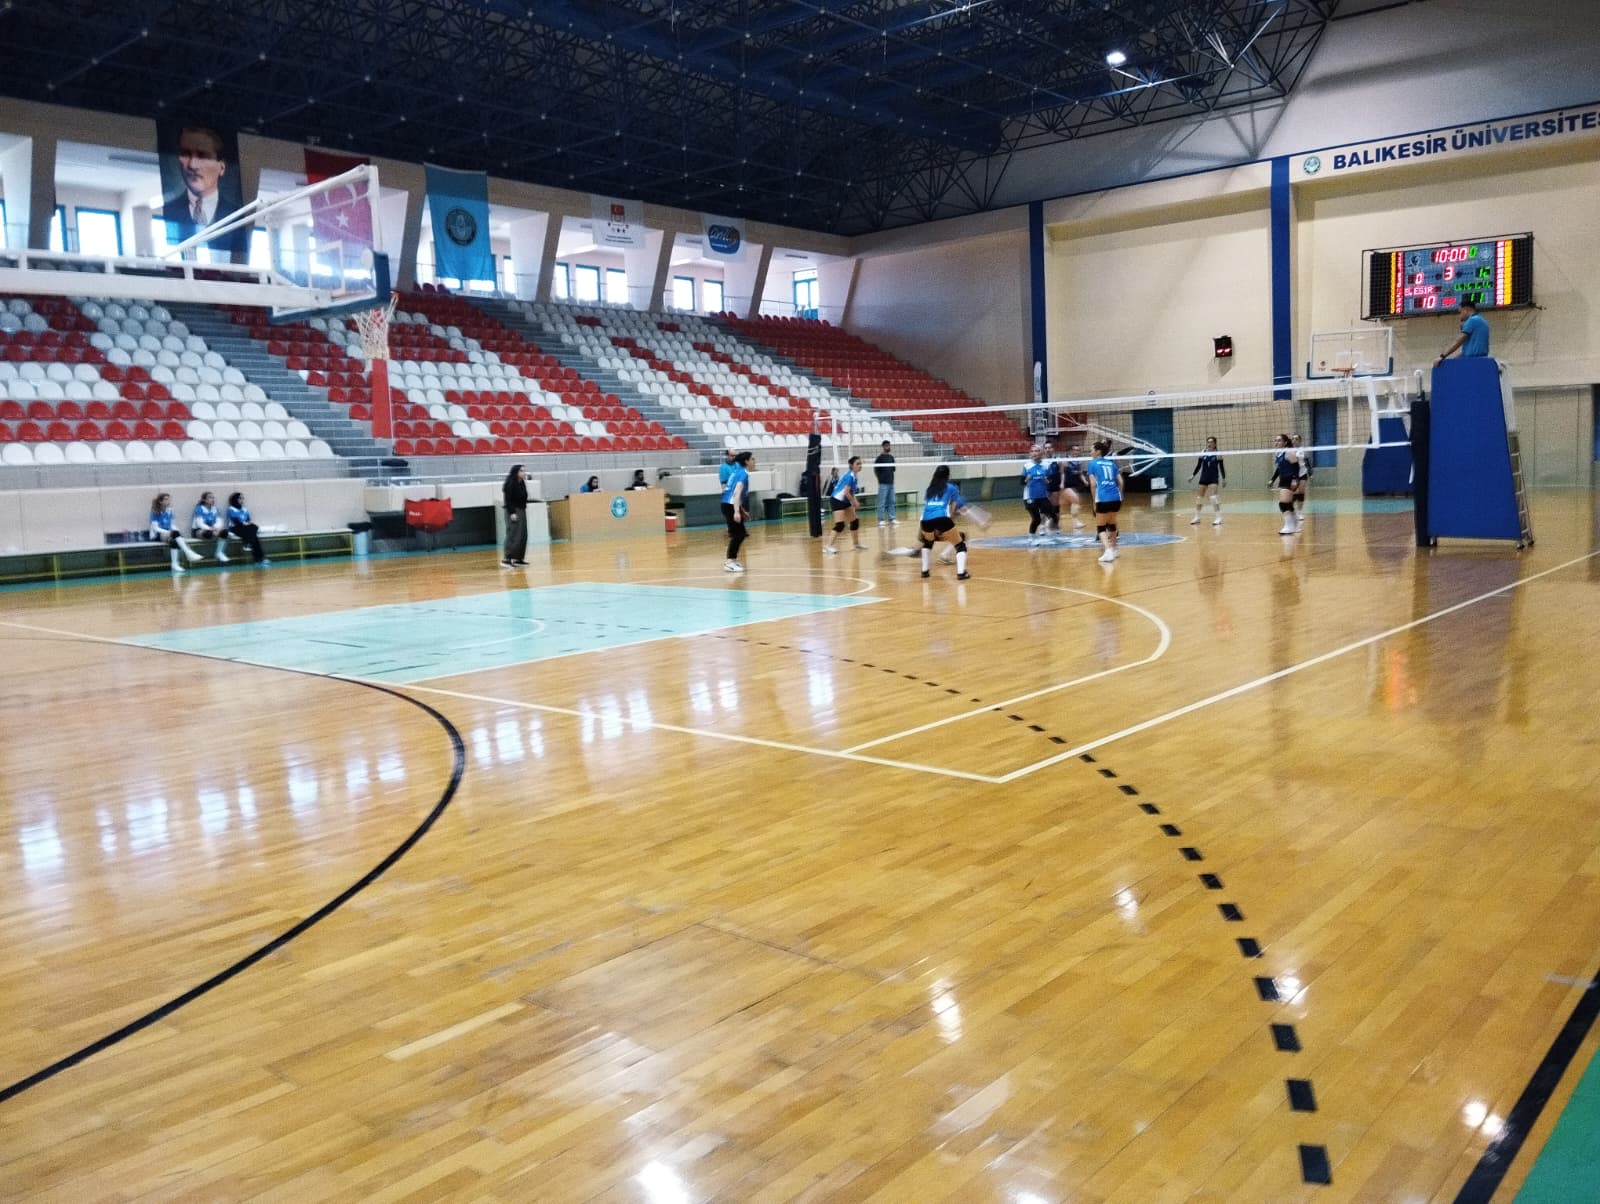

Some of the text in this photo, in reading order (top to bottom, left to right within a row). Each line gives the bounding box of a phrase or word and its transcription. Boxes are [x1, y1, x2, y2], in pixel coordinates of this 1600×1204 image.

[1333, 134, 1447, 170] BALIKESİR
[1434, 248, 1468, 263] 10:00
[1415, 272, 1424, 285] 0
[1444, 265, 1454, 281] 3
[1422, 295, 1436, 309] 10
[1102, 465, 1113, 480] 11
